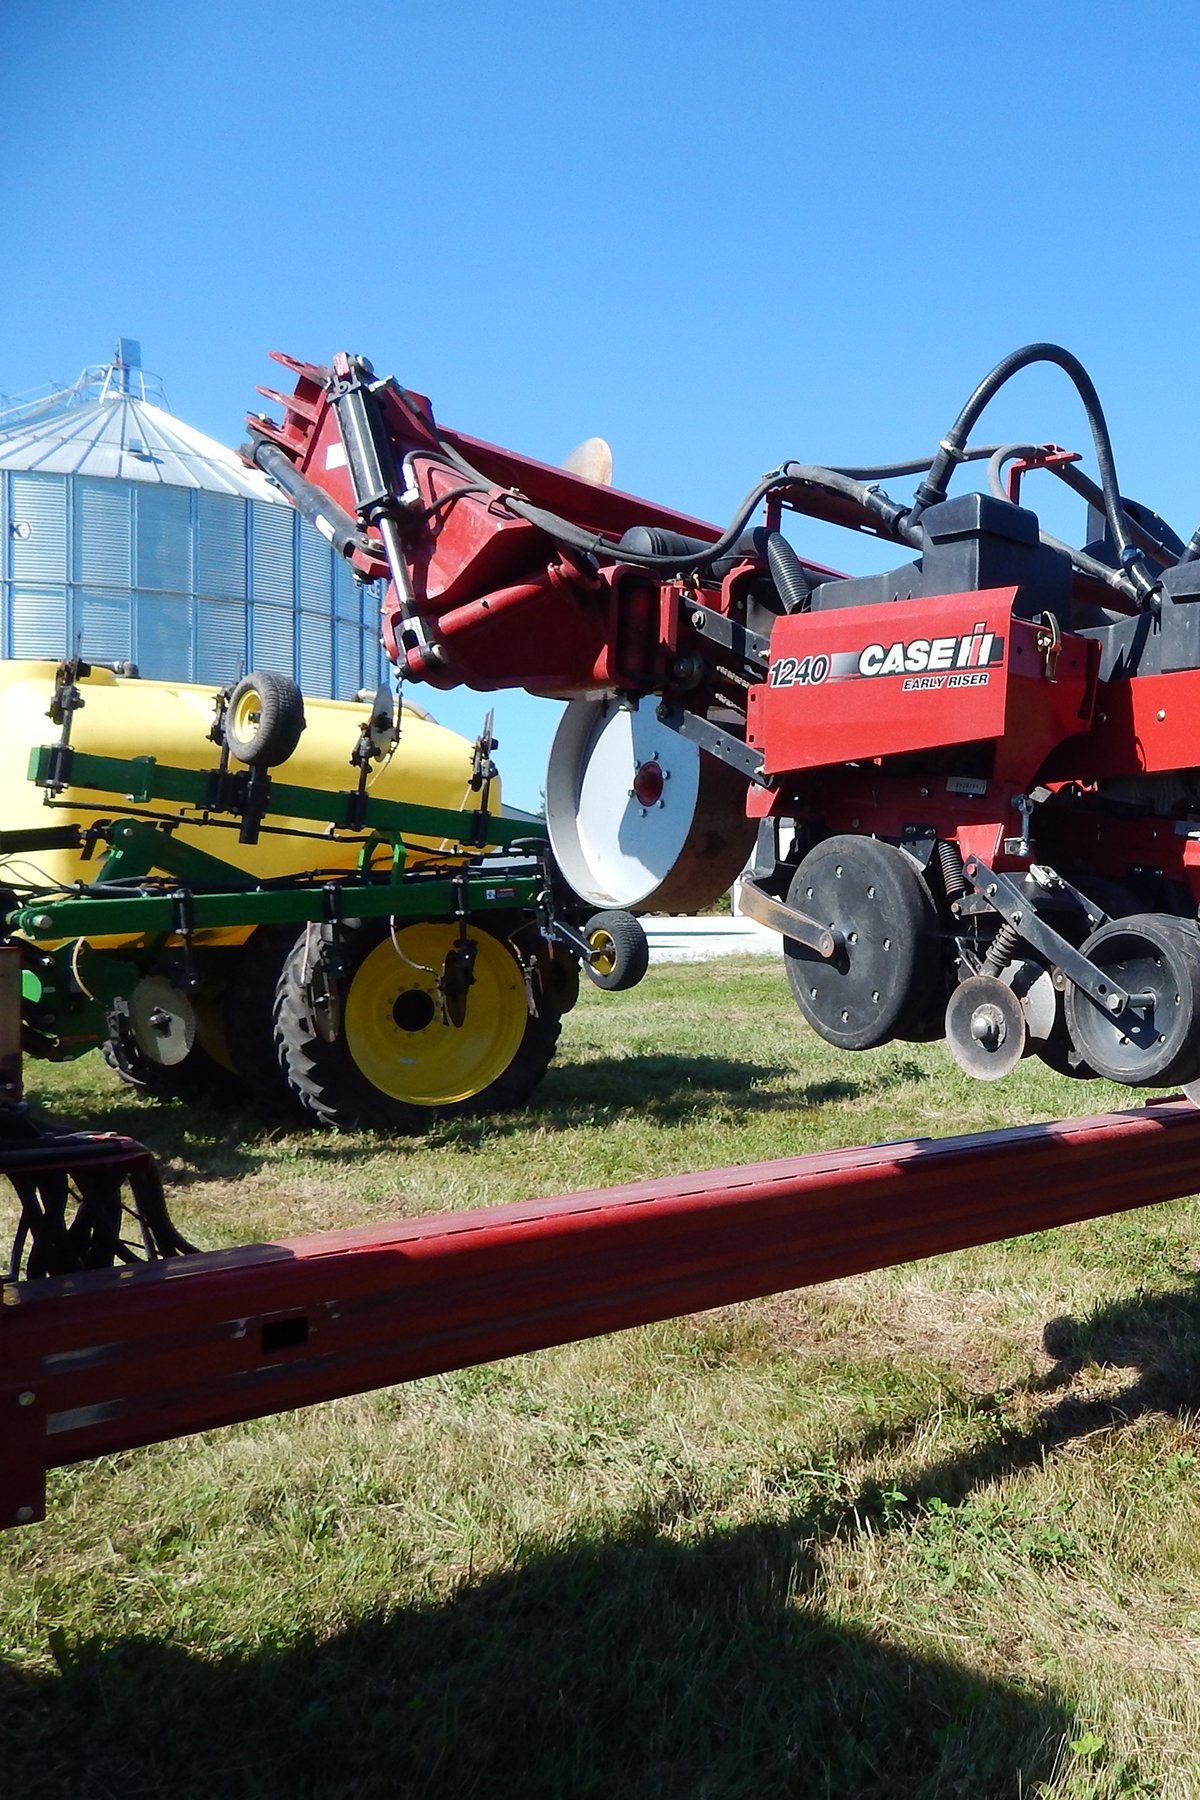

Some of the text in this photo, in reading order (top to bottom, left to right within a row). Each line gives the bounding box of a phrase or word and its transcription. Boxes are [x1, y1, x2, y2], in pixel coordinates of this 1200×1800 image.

[771, 655, 828, 687] 1240
[859, 637, 957, 676] CASE
[903, 674, 988, 690] EARLY RISER
